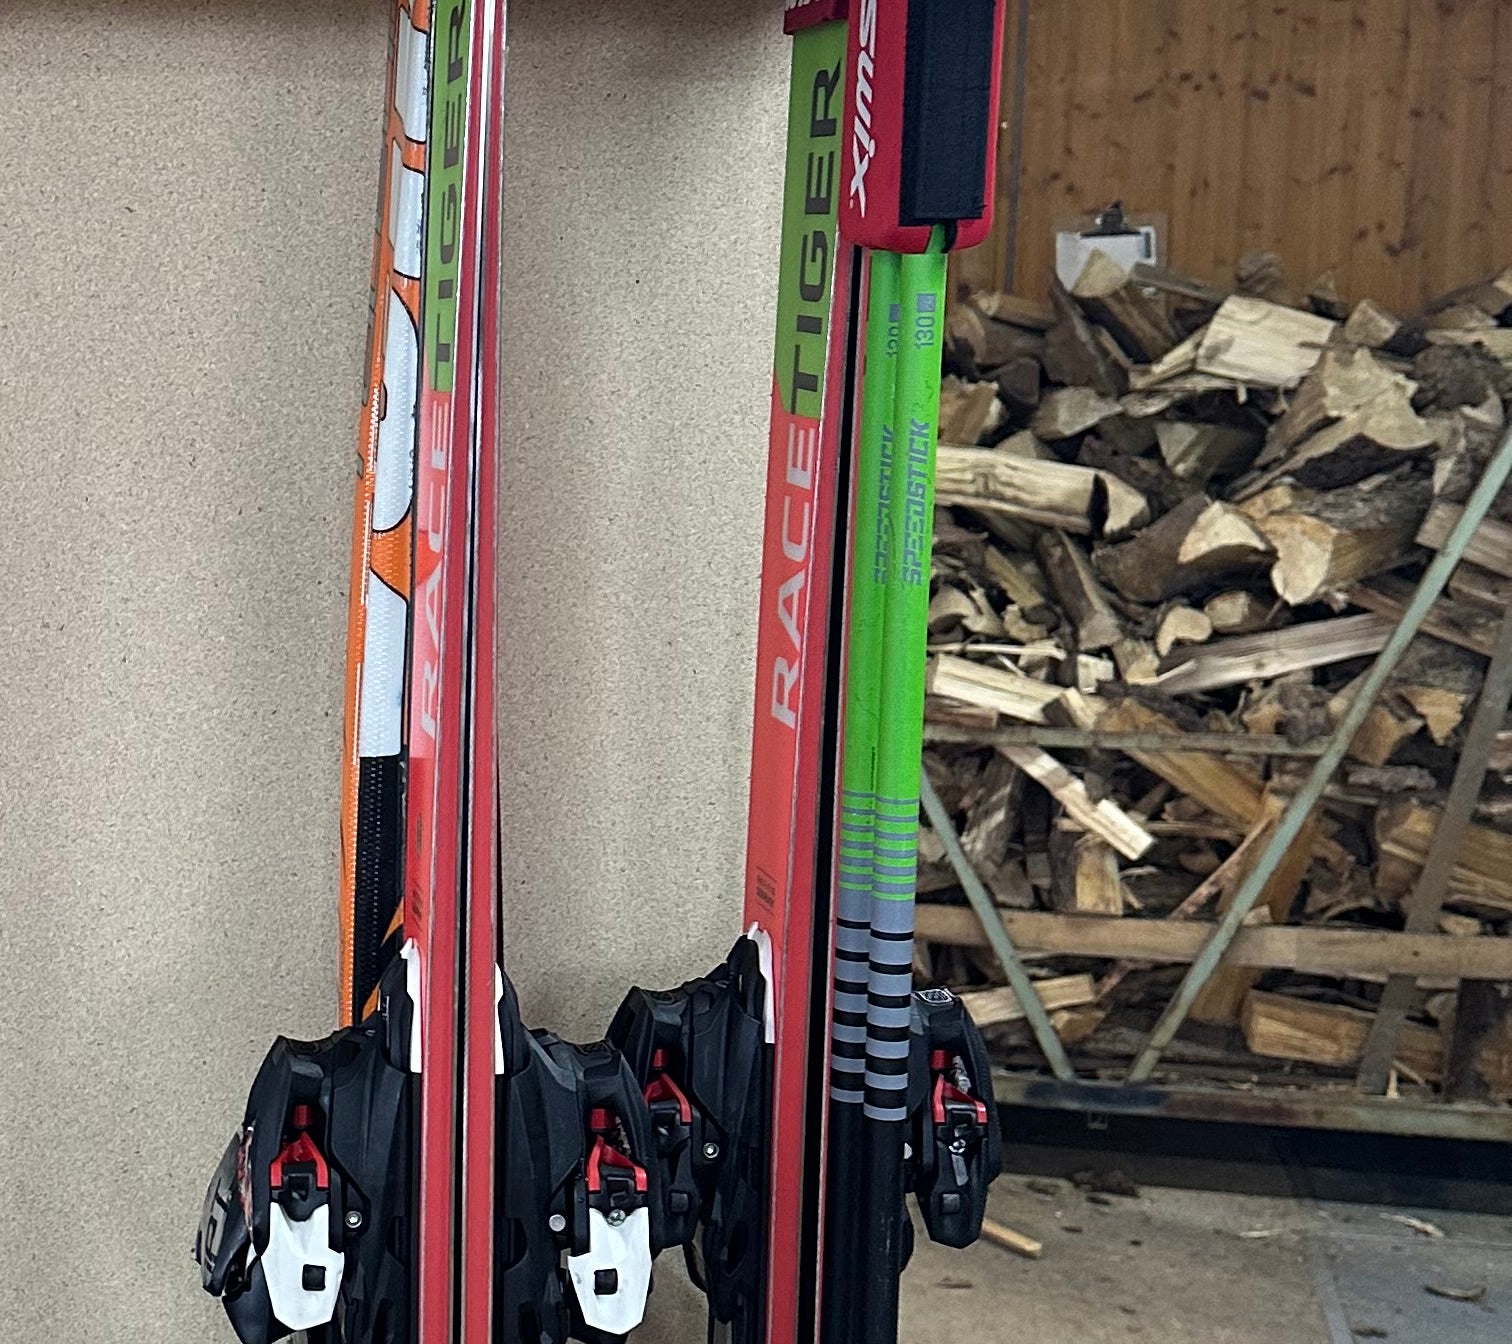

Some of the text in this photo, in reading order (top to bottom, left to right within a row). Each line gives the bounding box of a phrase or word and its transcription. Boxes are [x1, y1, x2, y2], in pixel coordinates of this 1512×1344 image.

[770, 57, 842, 730] RACE TIGER
[914, 315, 935, 350] 130
[418, 399, 449, 741] RACE
[902, 417, 931, 586] SPEEDSTICK
